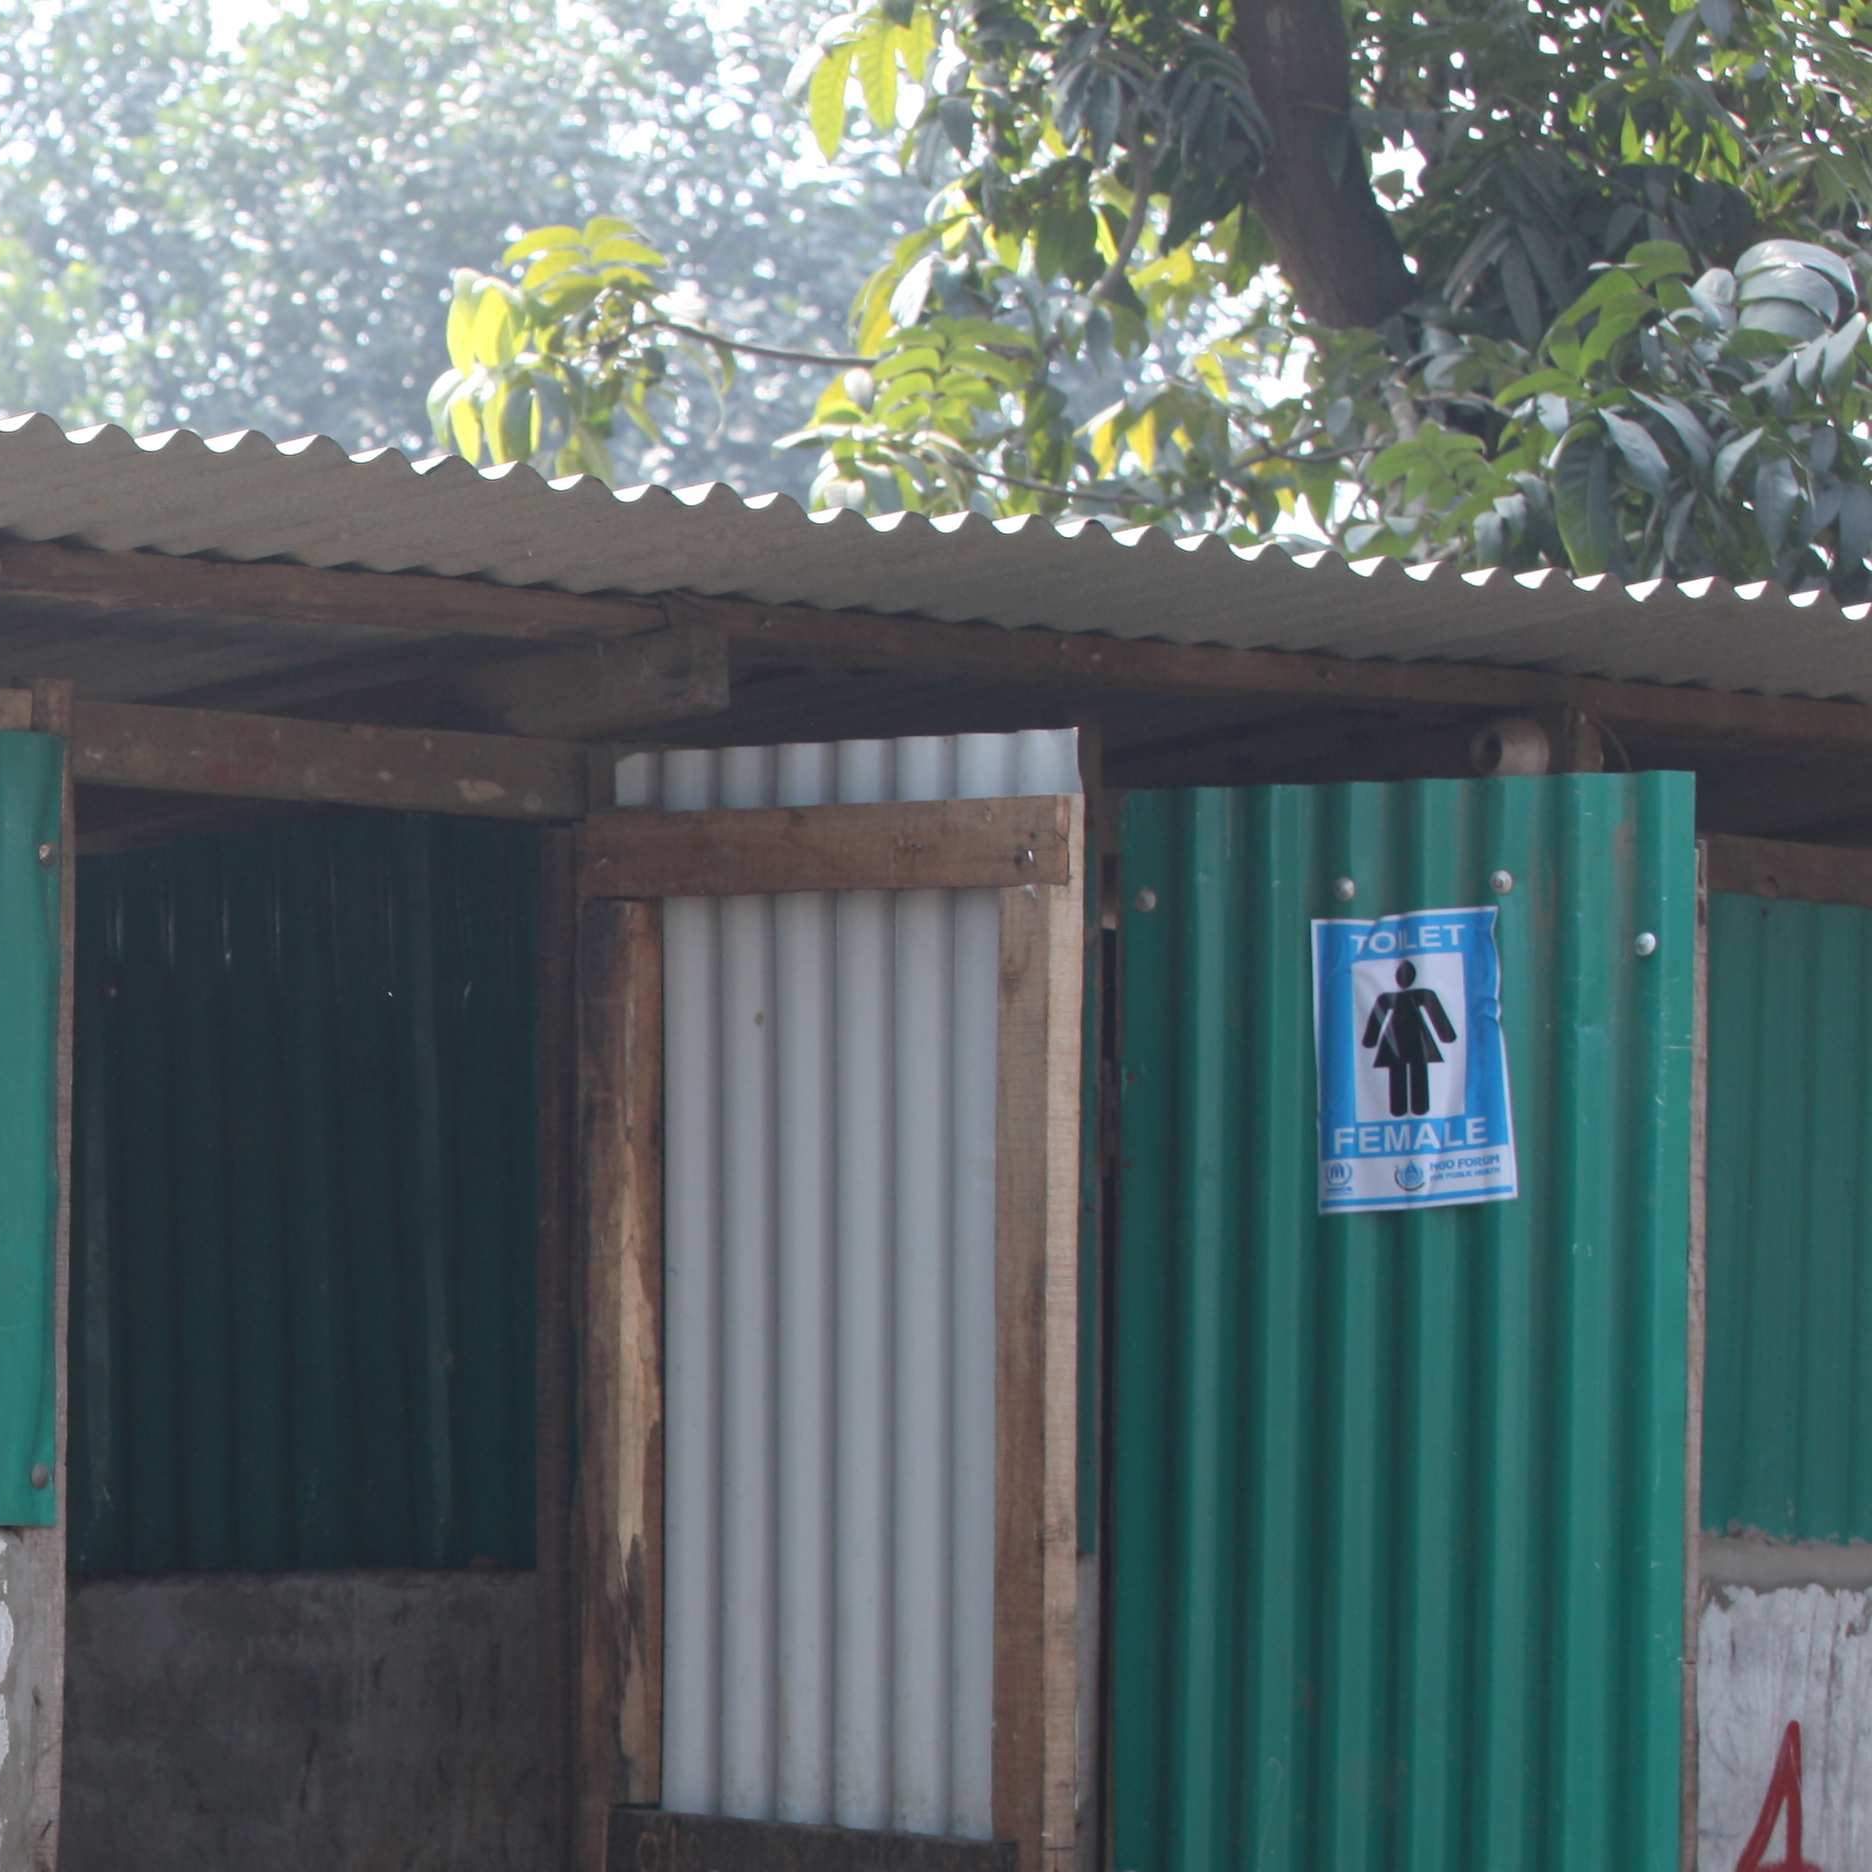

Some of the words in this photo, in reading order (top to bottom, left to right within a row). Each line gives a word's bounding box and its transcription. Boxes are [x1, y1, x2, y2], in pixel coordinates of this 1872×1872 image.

[1350, 923, 1465, 955] TOILET
[1333, 1116, 1489, 1155] FEMALE
[1457, 1154, 1500, 1169] FORUM
